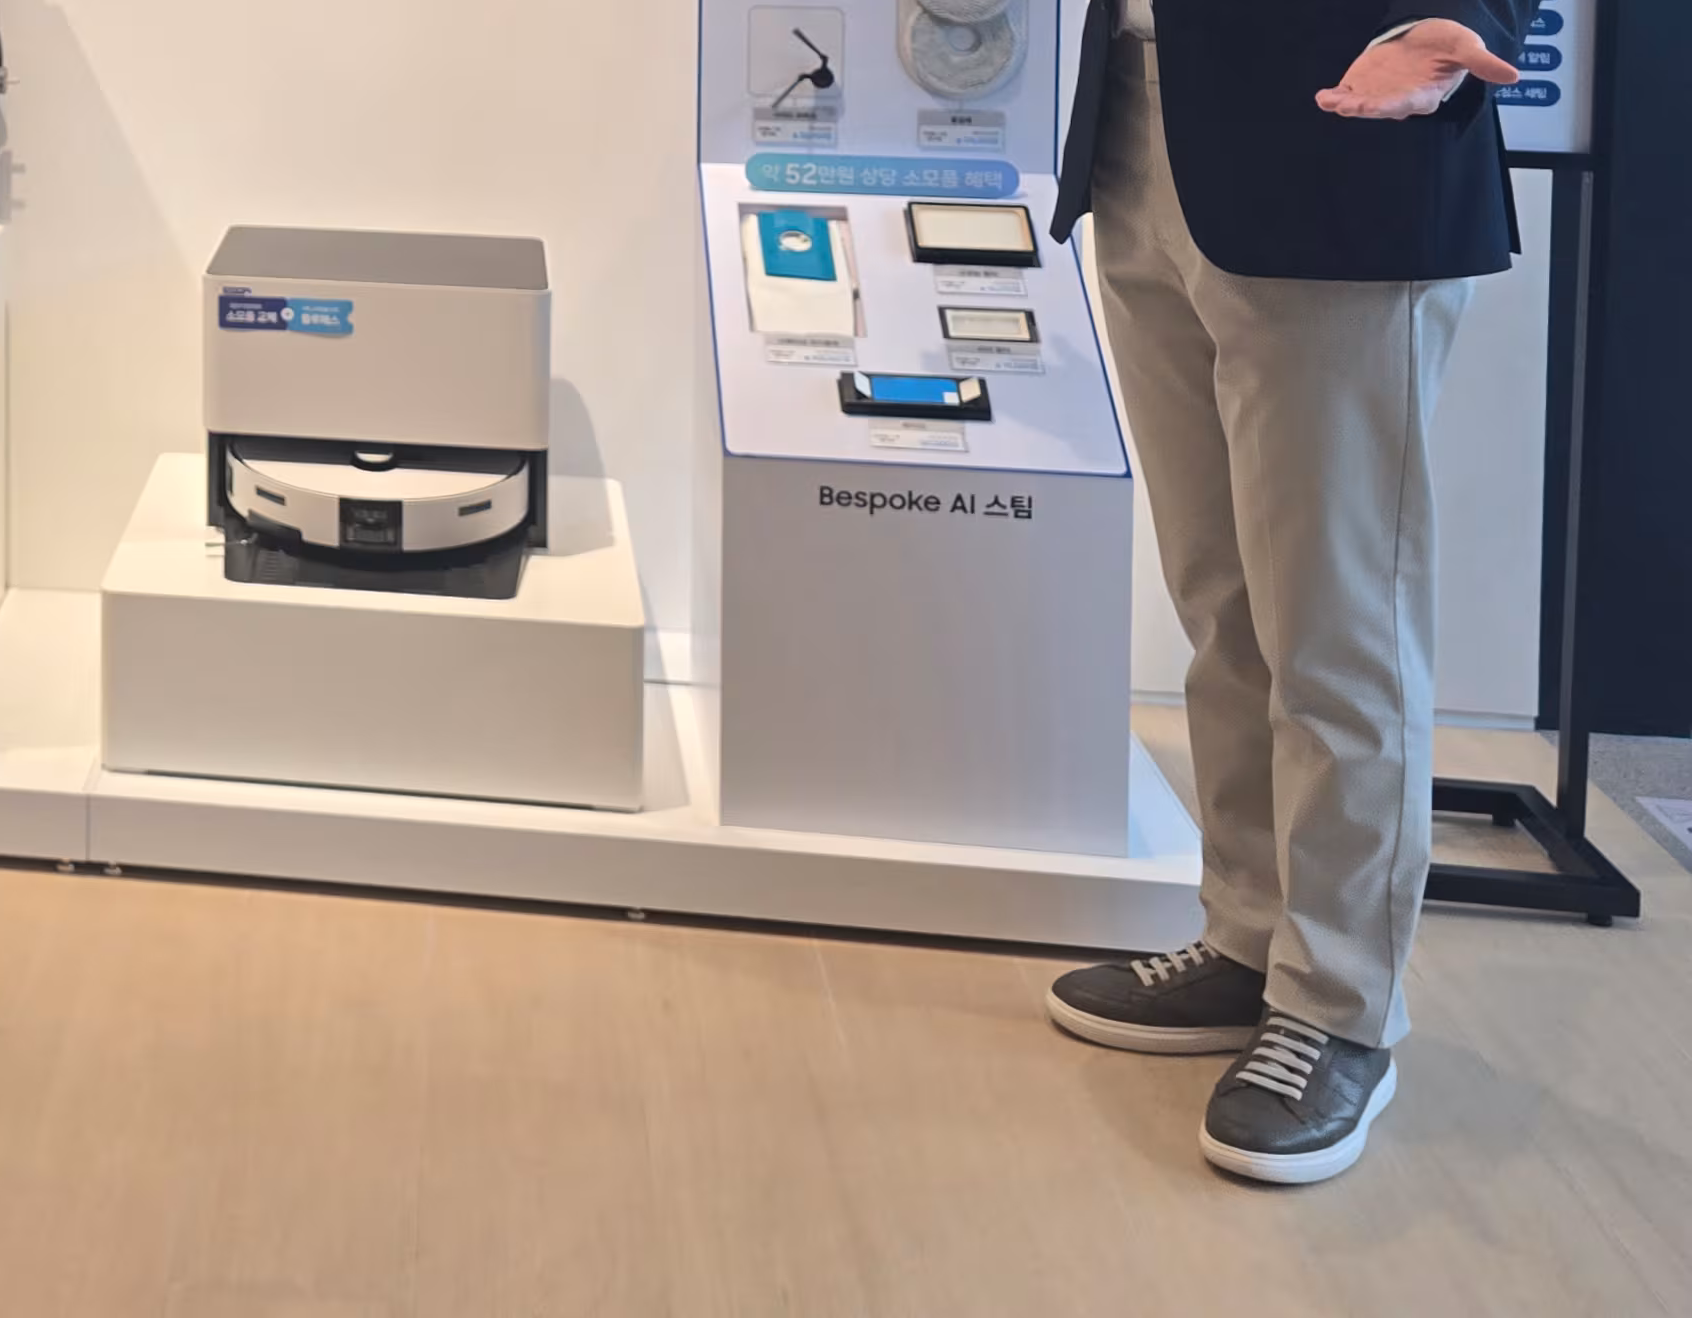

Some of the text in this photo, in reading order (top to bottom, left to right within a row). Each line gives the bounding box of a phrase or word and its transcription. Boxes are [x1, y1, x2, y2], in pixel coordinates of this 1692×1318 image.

[761, 162, 1004, 190] 약 52만원 상당 소모품 혜택
[819, 485, 1033, 520] Bespoke AI 스팀
